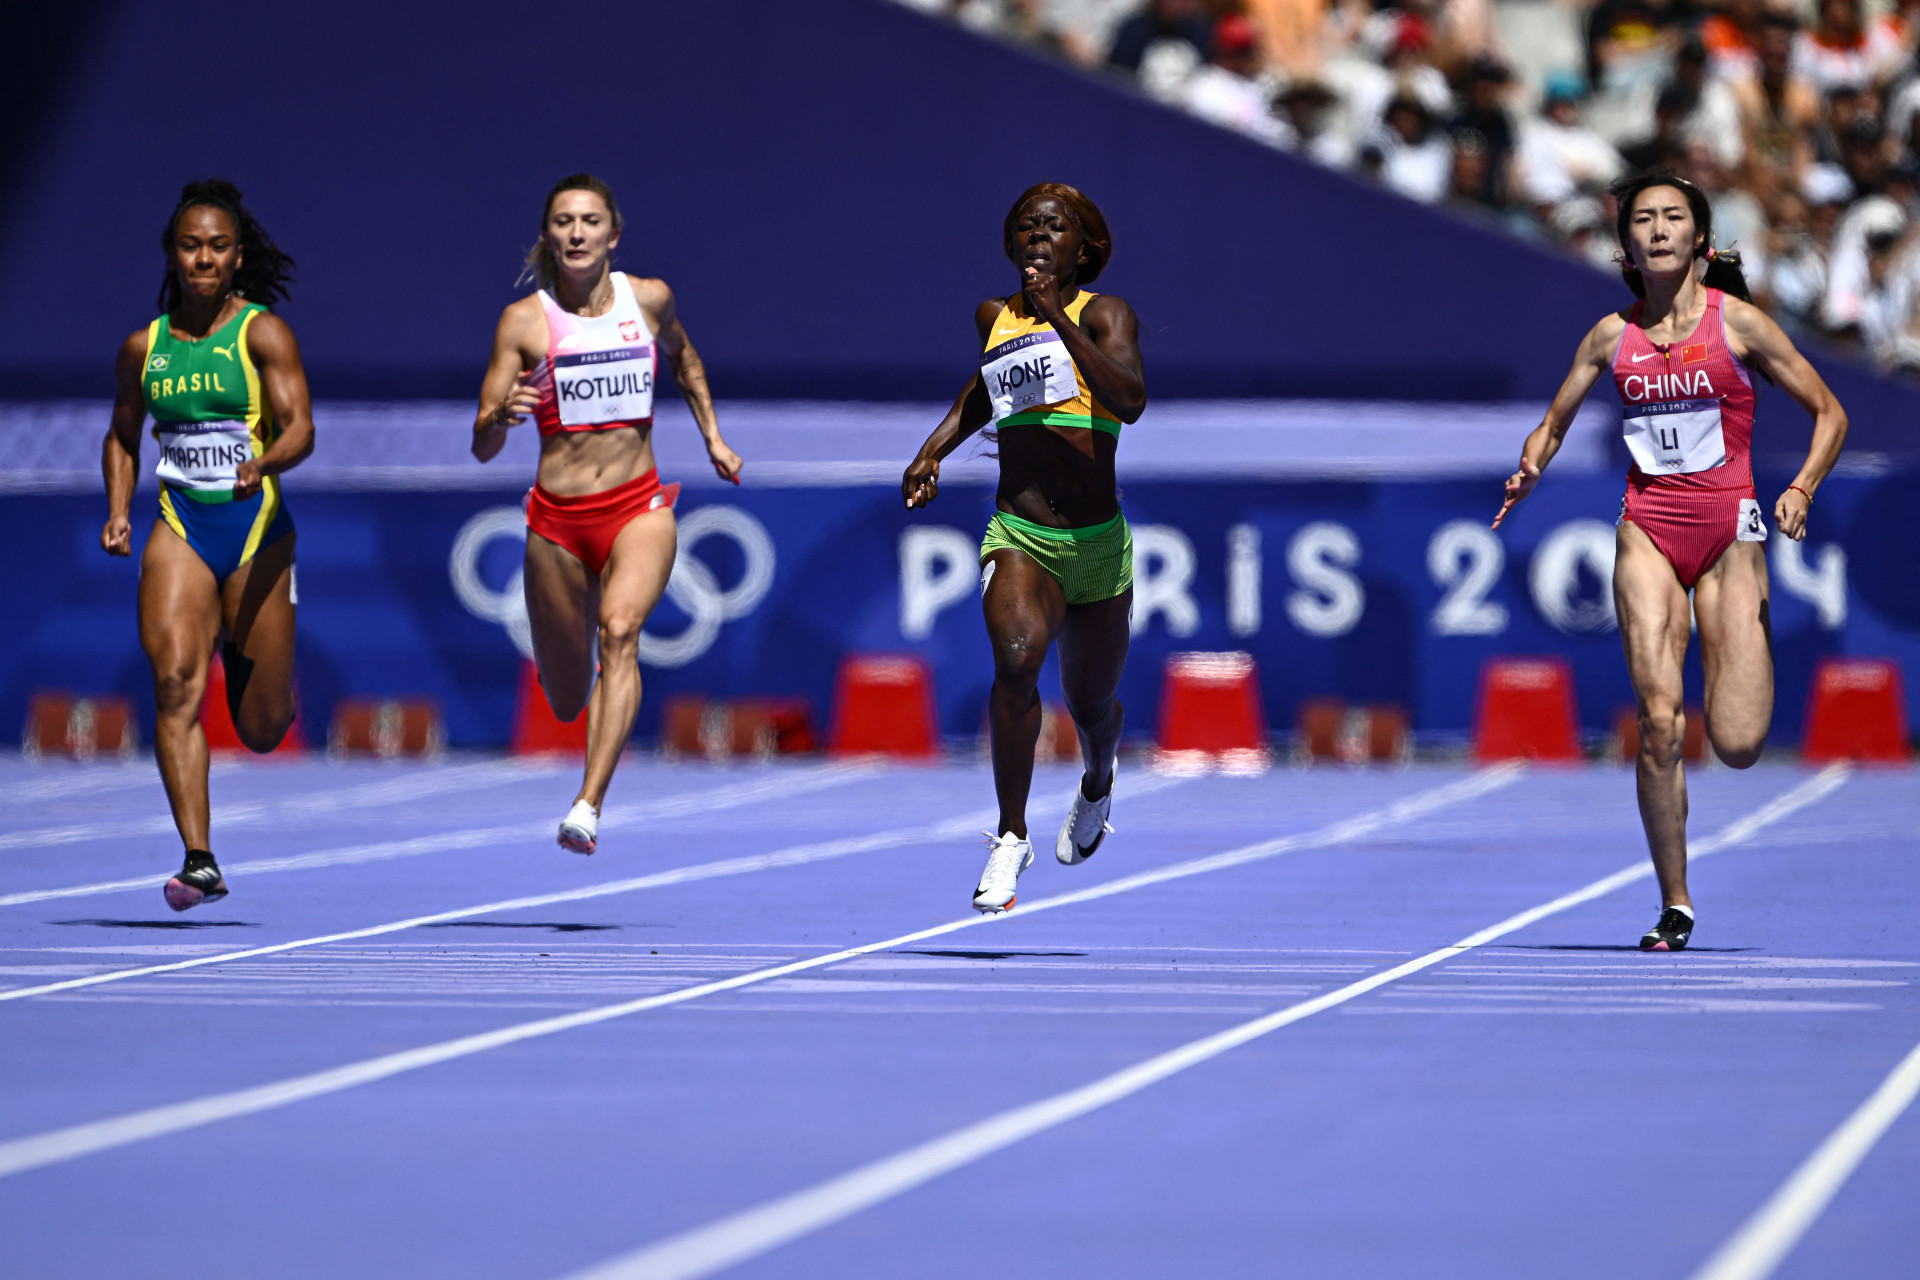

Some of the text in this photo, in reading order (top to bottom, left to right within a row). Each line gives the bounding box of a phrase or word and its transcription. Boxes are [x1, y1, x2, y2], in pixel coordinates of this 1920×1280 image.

[999, 335, 1042, 354] PARIS 2024
[151, 372, 225, 400] BRASIL
[560, 371, 652, 401] KOTWILA
[997, 355, 1055, 394] KONE
[1624, 369, 1714, 401] CHINA
[1642, 402, 1692, 413] PARIS 2024
[1660, 427, 1679, 450] LI
[164, 443, 246, 468] MARTINS
[1749, 507, 1760, 533] 3
[898, 521, 1847, 638] PRIS 204
